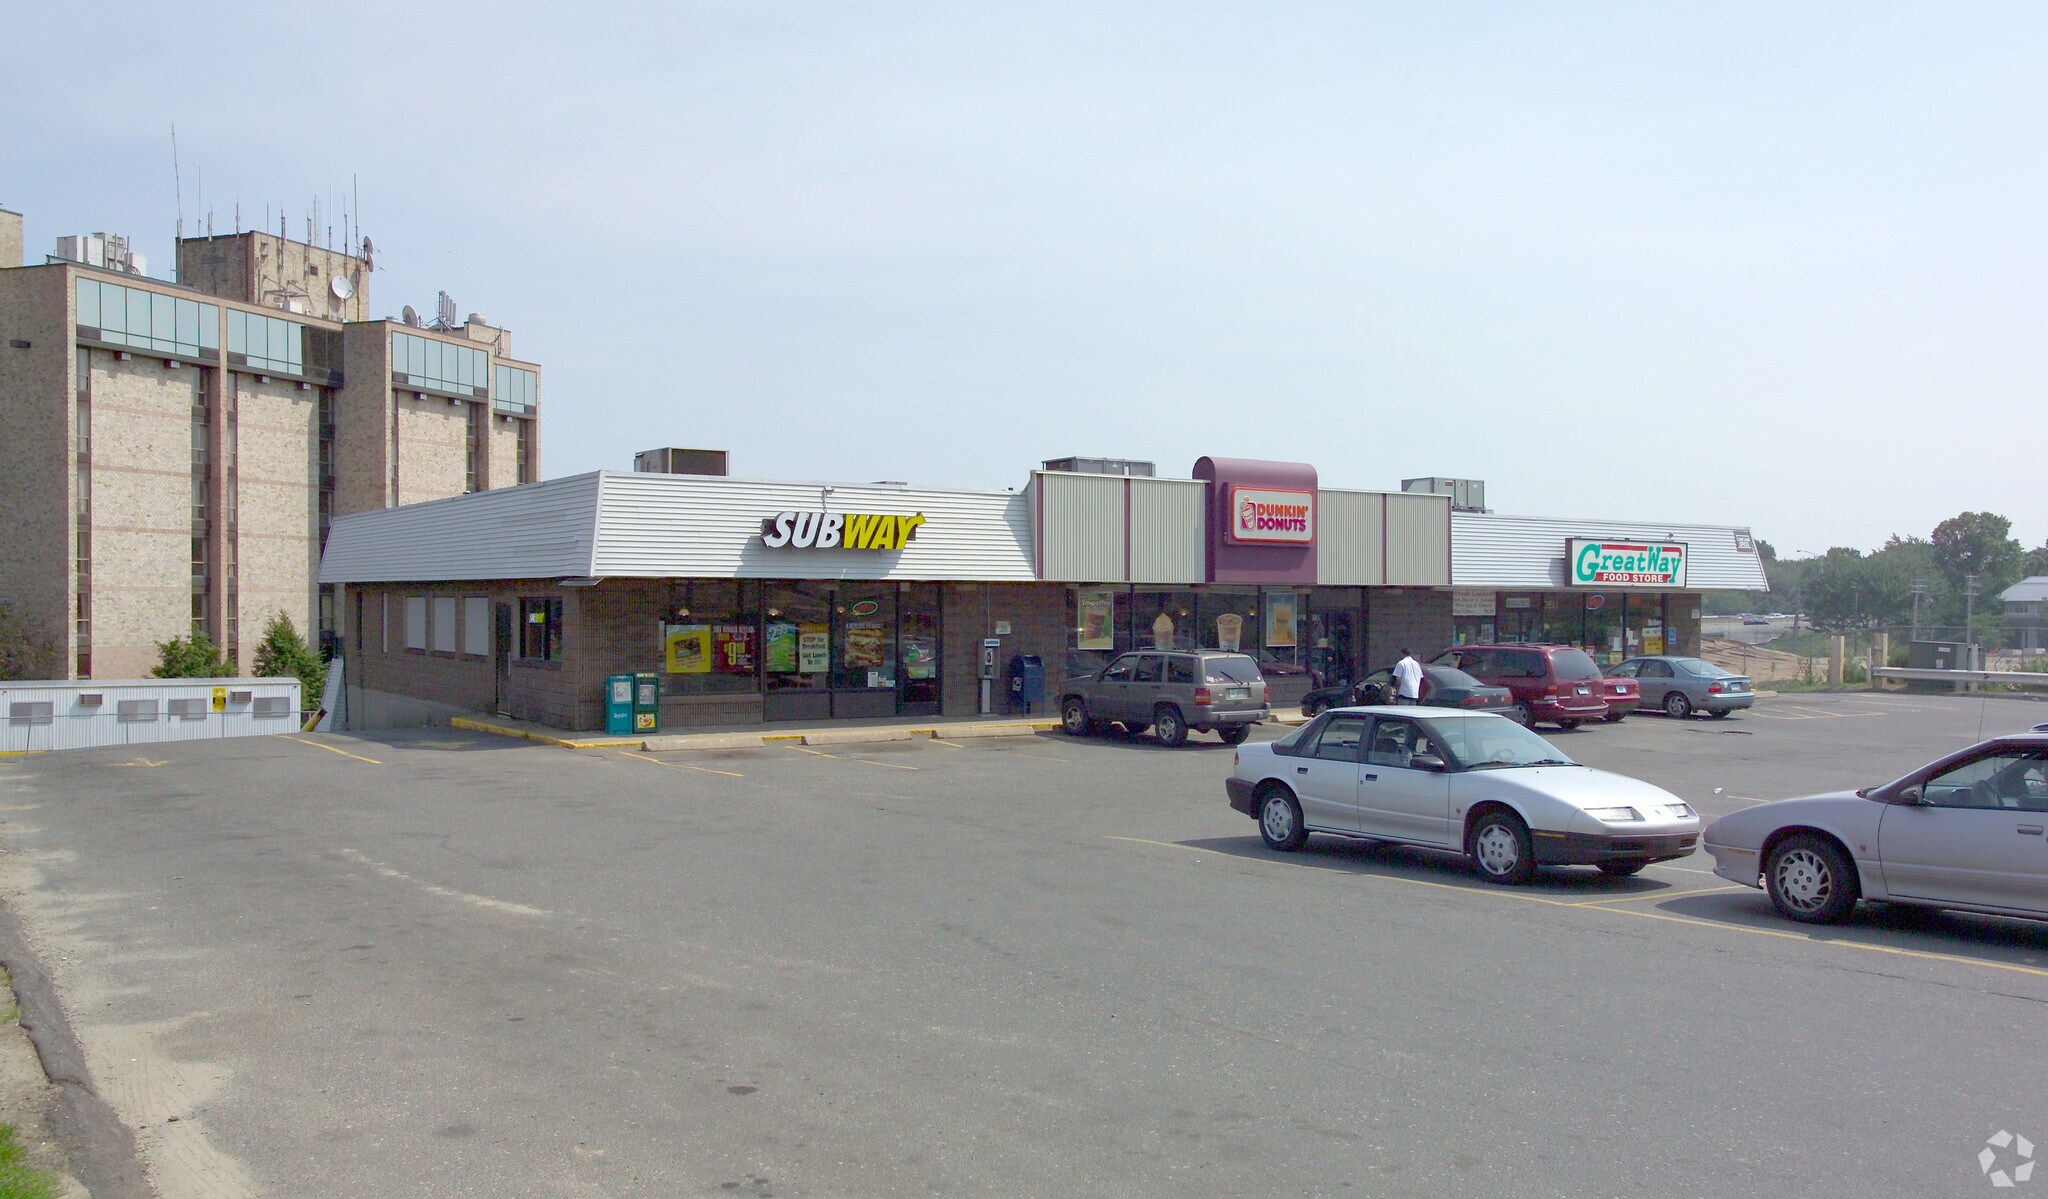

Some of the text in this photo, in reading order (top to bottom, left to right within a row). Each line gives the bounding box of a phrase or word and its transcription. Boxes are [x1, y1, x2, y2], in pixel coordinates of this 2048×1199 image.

[1257, 503, 1309, 518] DUNKIN'
[763, 511, 926, 550] SUBWAY
[1257, 517, 1307, 532] DONUTS
[1603, 572, 1664, 583] FOOD STORE
[1081, 599, 1112, 608] Smoothie
